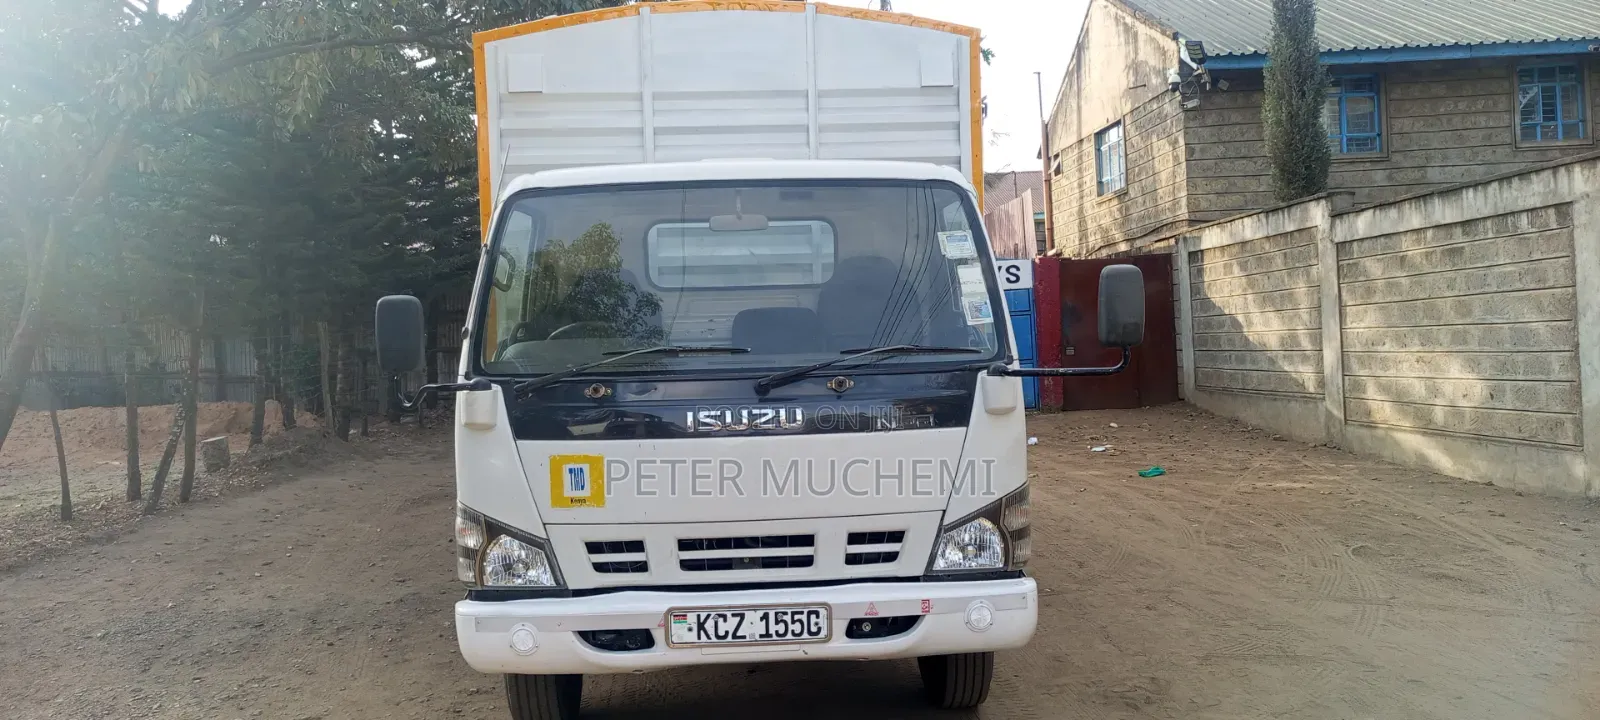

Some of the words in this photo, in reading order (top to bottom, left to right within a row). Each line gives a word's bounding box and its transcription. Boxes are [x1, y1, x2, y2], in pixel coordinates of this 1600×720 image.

[686, 407, 802, 432] ISUZU
[568, 467, 586, 491] TMD
[570, 498, 587, 506] Kenya
[696, 612, 747, 641] KCZ
[758, 609, 822, 640] 155C
